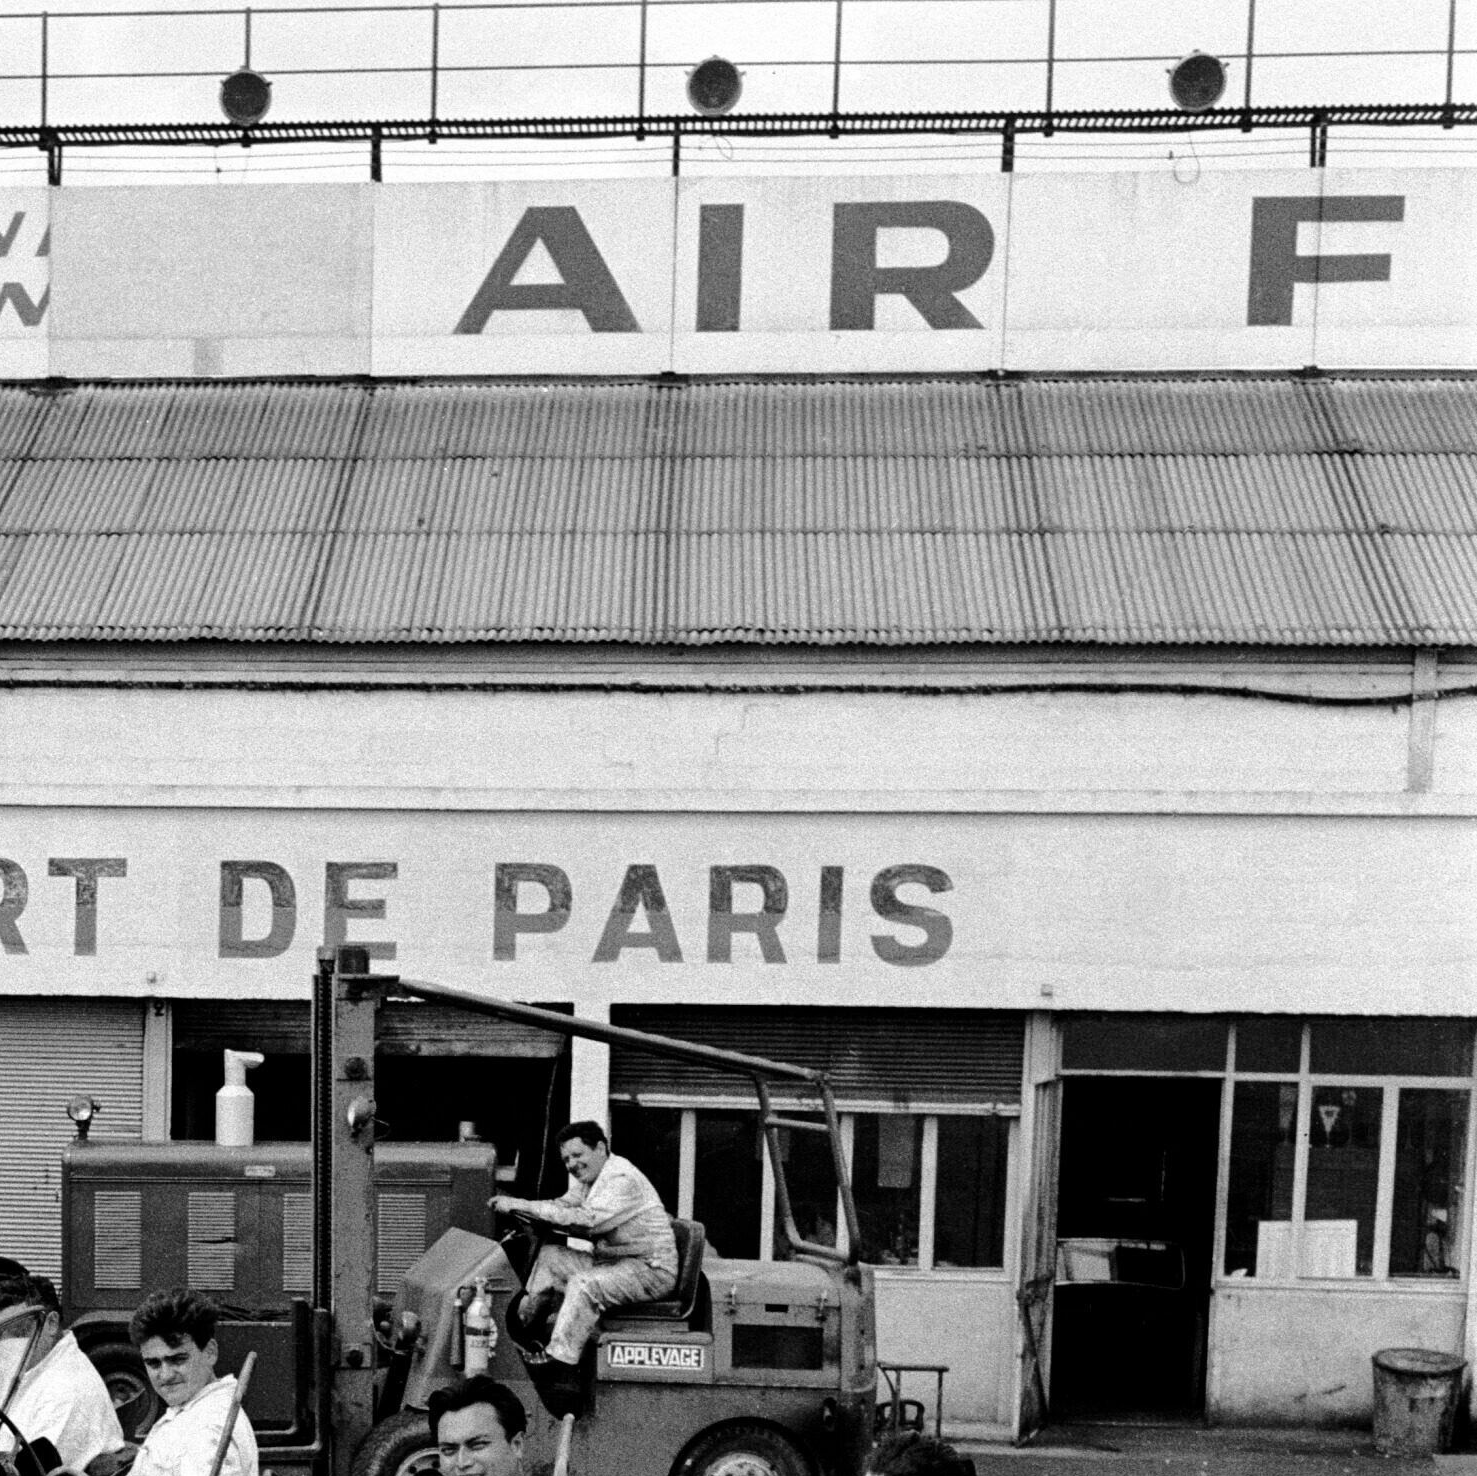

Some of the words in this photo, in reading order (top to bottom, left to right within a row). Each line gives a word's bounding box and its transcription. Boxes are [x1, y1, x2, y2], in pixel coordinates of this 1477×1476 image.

[451, 199, 997, 334] AIR
[1246, 194, 1405, 327] F
[217, 859, 399, 961] DE
[493, 863, 955, 968] PARIS
[612, 1346, 700, 1367] APPLEVAGE
